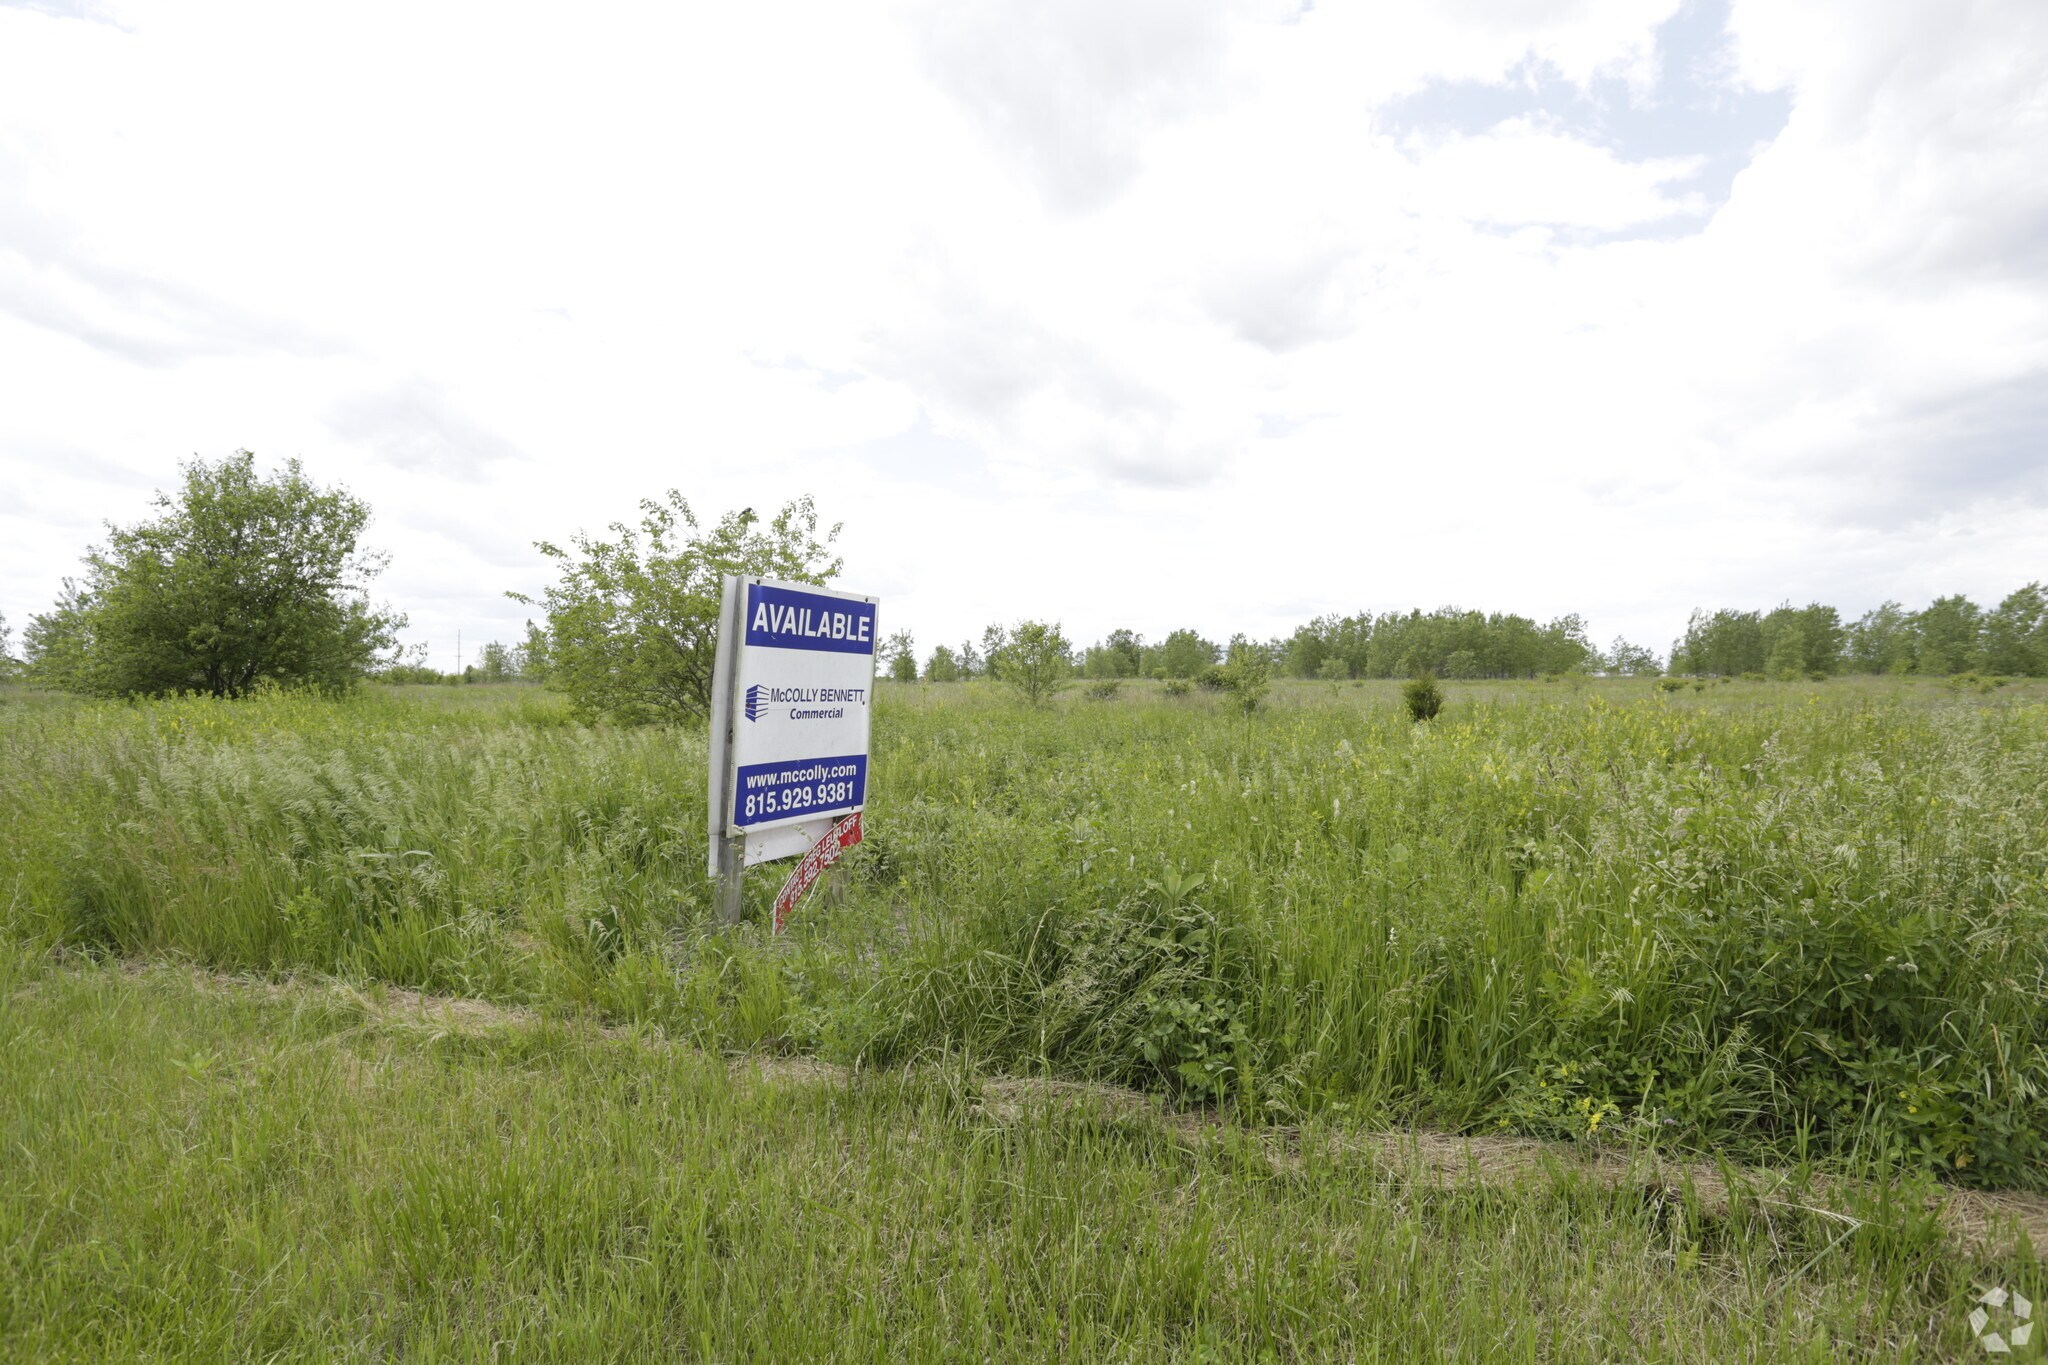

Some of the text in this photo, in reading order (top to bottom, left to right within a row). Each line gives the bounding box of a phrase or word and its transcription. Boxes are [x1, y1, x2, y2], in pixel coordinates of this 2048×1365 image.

[752, 602, 870, 642] AVAILABLE
[771, 688, 865, 703] McCOLLY BENNETT
[790, 707, 844, 720] Commercial
[747, 764, 857, 789] www.mccolly.com
[745, 781, 854, 817] 815.929.9381
